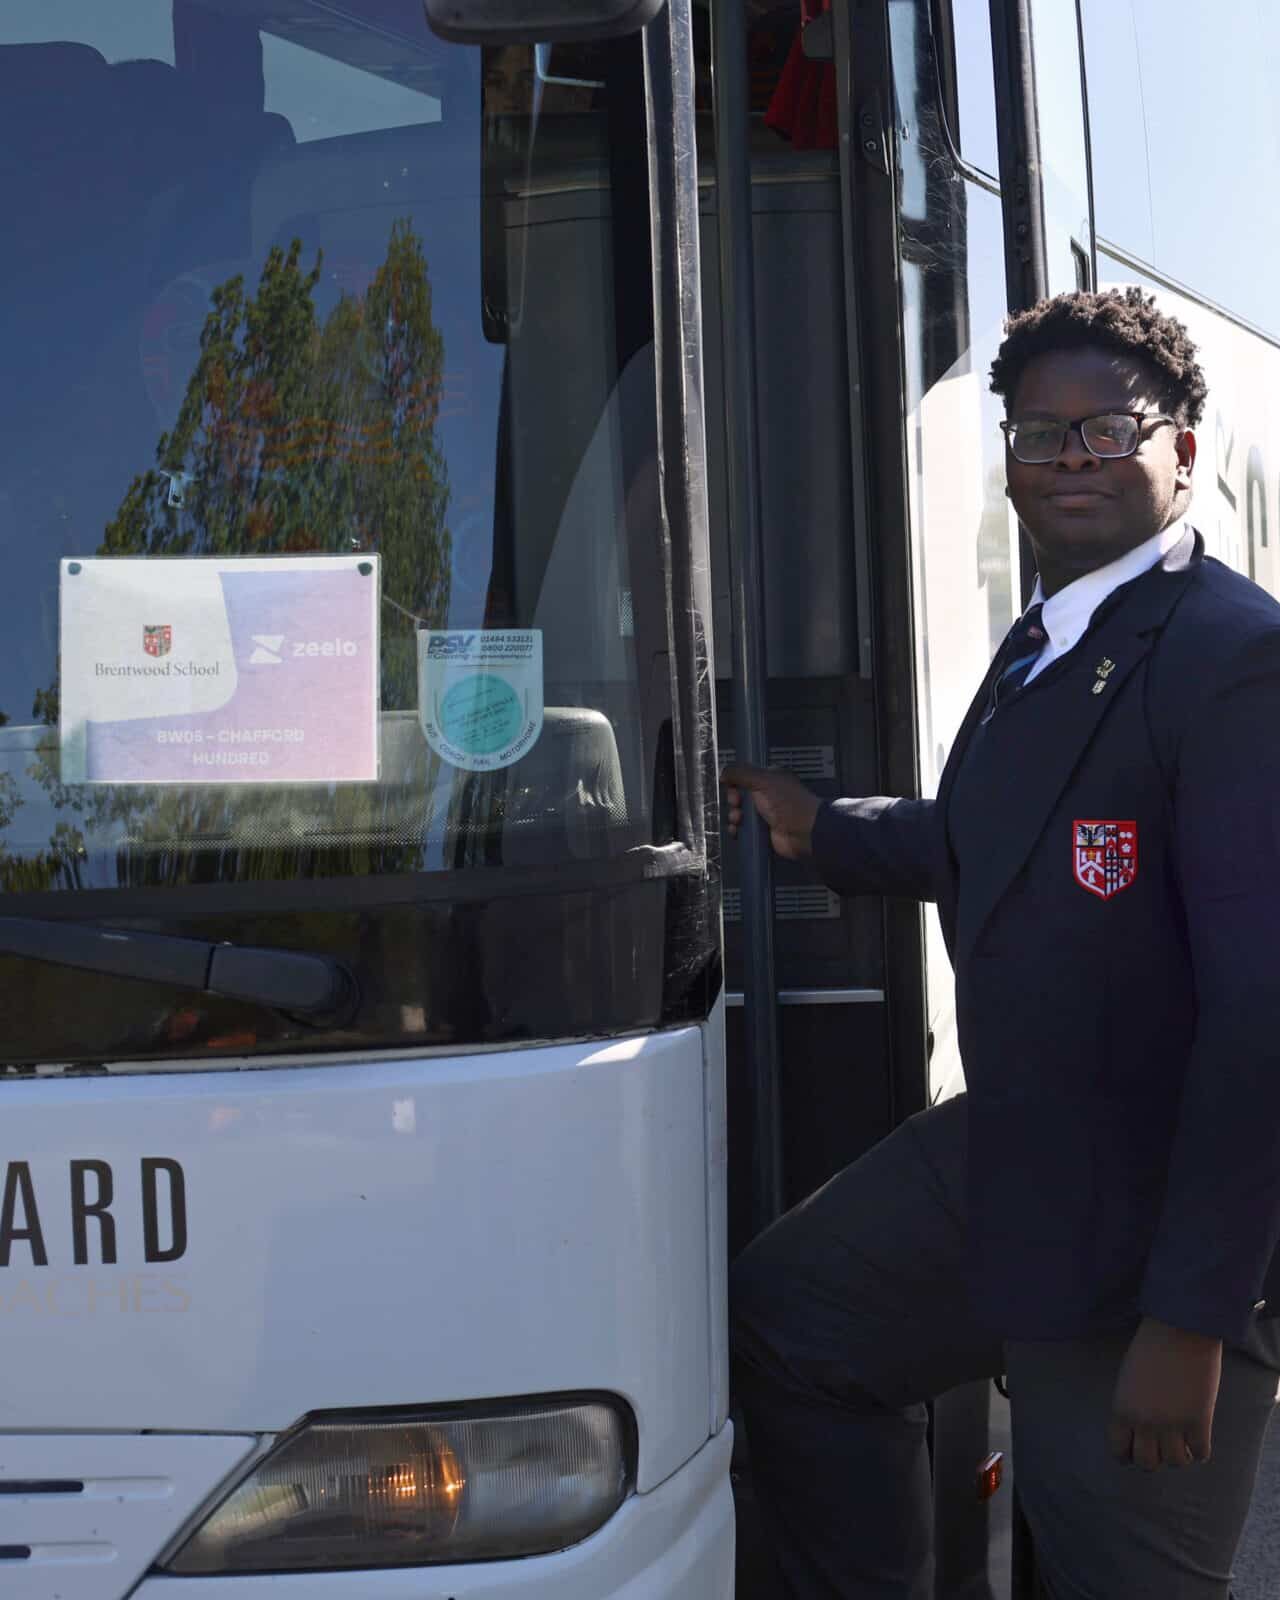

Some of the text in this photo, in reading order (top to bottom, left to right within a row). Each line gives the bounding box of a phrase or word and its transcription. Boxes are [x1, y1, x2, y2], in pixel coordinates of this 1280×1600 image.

[293, 637, 358, 658] zeelo
[95, 661, 220, 677] Brentwood School
[216, 728, 304, 744] CHAFFORD
[192, 752, 269, 766] HUNDRED
[0, 1157, 188, 1268] ARD
[0, 1274, 192, 1315] ACHES
